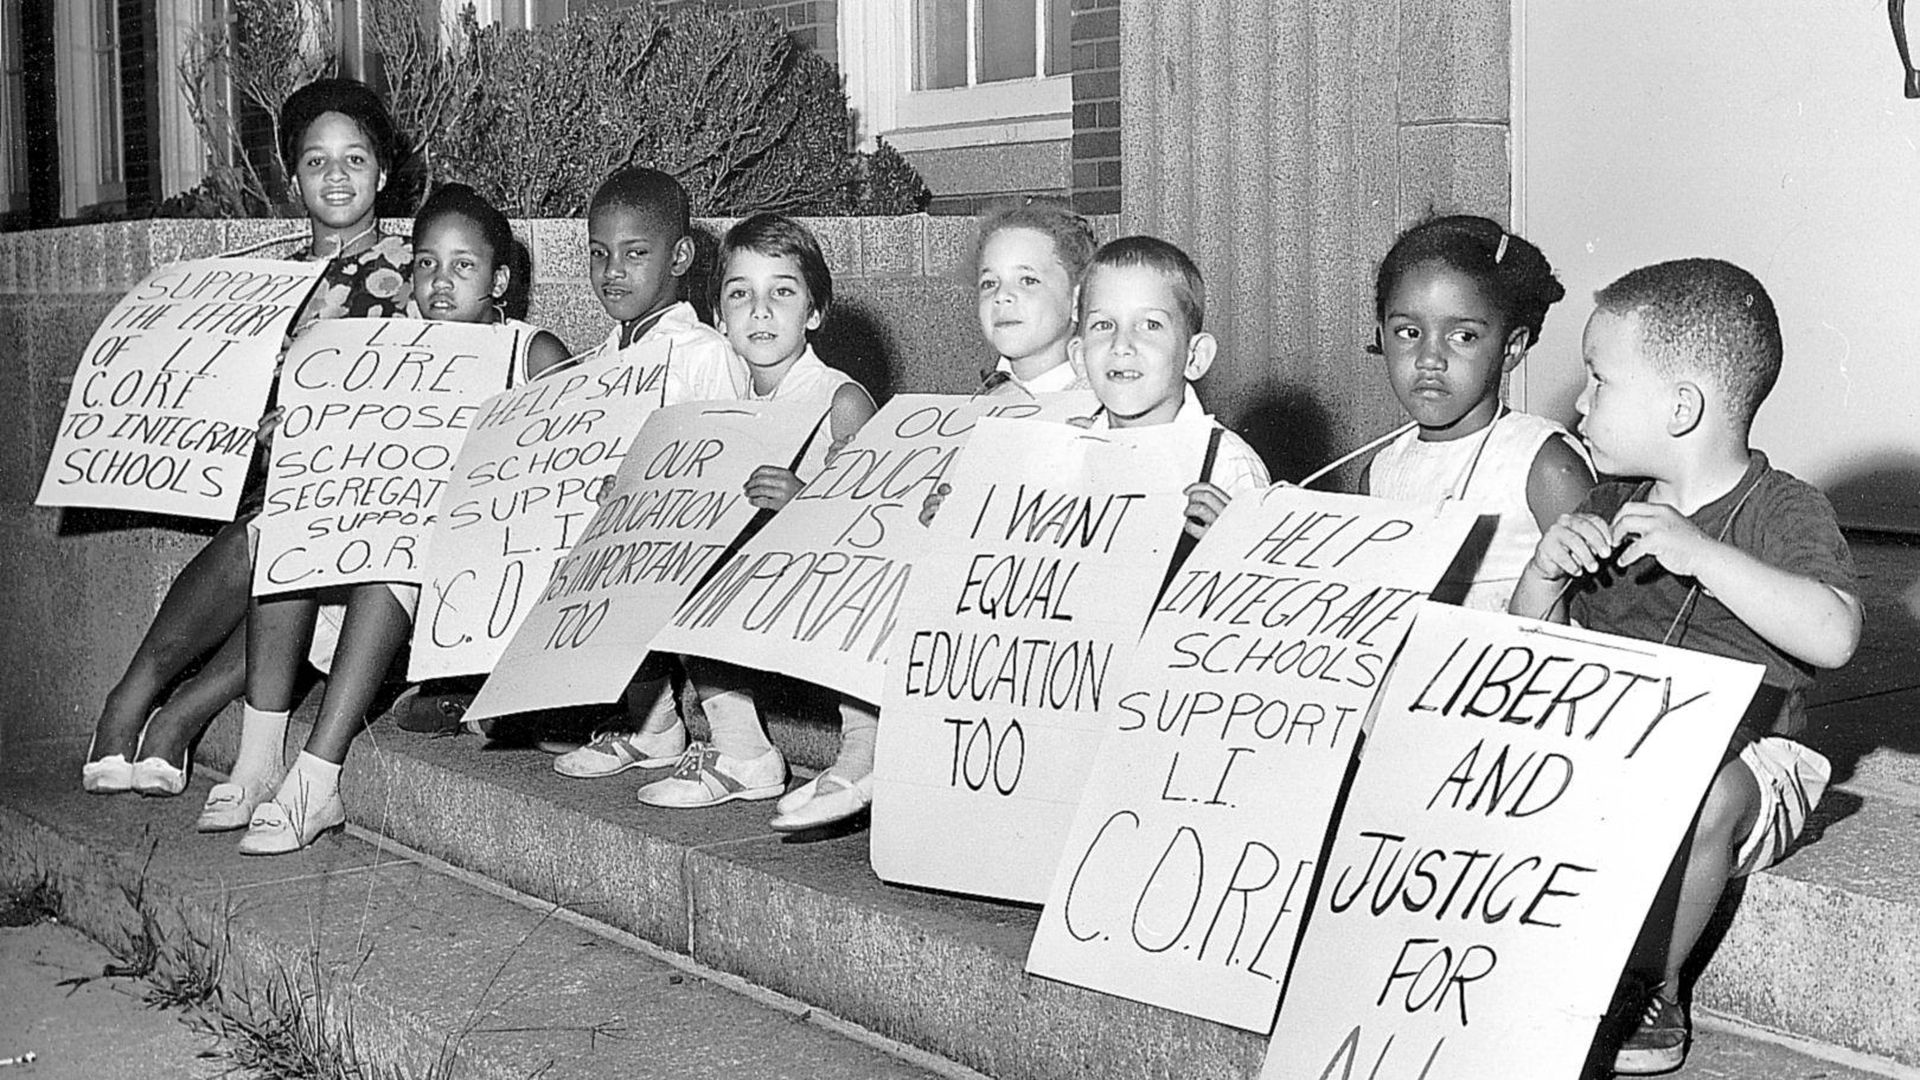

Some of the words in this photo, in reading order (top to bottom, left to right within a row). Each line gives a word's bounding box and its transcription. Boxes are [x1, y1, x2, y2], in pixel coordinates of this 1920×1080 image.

[137, 270, 317, 302] SUPPORT
[111, 303, 182, 330] THE
[177, 303, 297, 337] EFFORT
[92, 335, 142, 367] OF
[294, 348, 479, 394] C.O.R.E.
[283, 404, 480, 438] OPPOSE
[477, 374, 588, 430] HELP
[585, 363, 667, 400] SAVE
[62, 413, 104, 440] TO
[108, 412, 256, 458] INTEGRATE
[516, 409, 605, 447] OUR
[58, 448, 223, 498] SCHOOLS
[275, 442, 455, 478] SCHOO
[644, 438, 724, 480] OUR
[796, 446, 960, 501] EDUCA
[267, 476, 448, 516] SEGREGAT
[450, 477, 605, 529] SUPPO
[582, 489, 741, 546] EDUCATION
[970, 484, 996, 539] I
[1005, 484, 1146, 553] WANT
[833, 503, 904, 549] IS
[1244, 511, 1414, 569] HELP
[267, 535, 417, 584] C.O.R.
[563, 540, 726, 598] IMPORTANT
[956, 554, 1080, 620] EQUAL
[544, 597, 610, 650] TOO
[673, 552, 912, 663] IMPORTAN
[1158, 570, 1430, 648] INTEGRATE
[906, 630, 1113, 713] EDUCATION
[1168, 631, 1383, 689] SCHOOLS
[1118, 690, 1359, 749] SUPPORT
[1408, 637, 1711, 759] LIBERTY
[943, 716, 1025, 796] TOO
[1425, 738, 1575, 818] AND
[1064, 809, 1313, 985] C.O.R.E.
[1330, 832, 1598, 928] JUSTICE
[1377, 938, 1498, 1026] FOR
